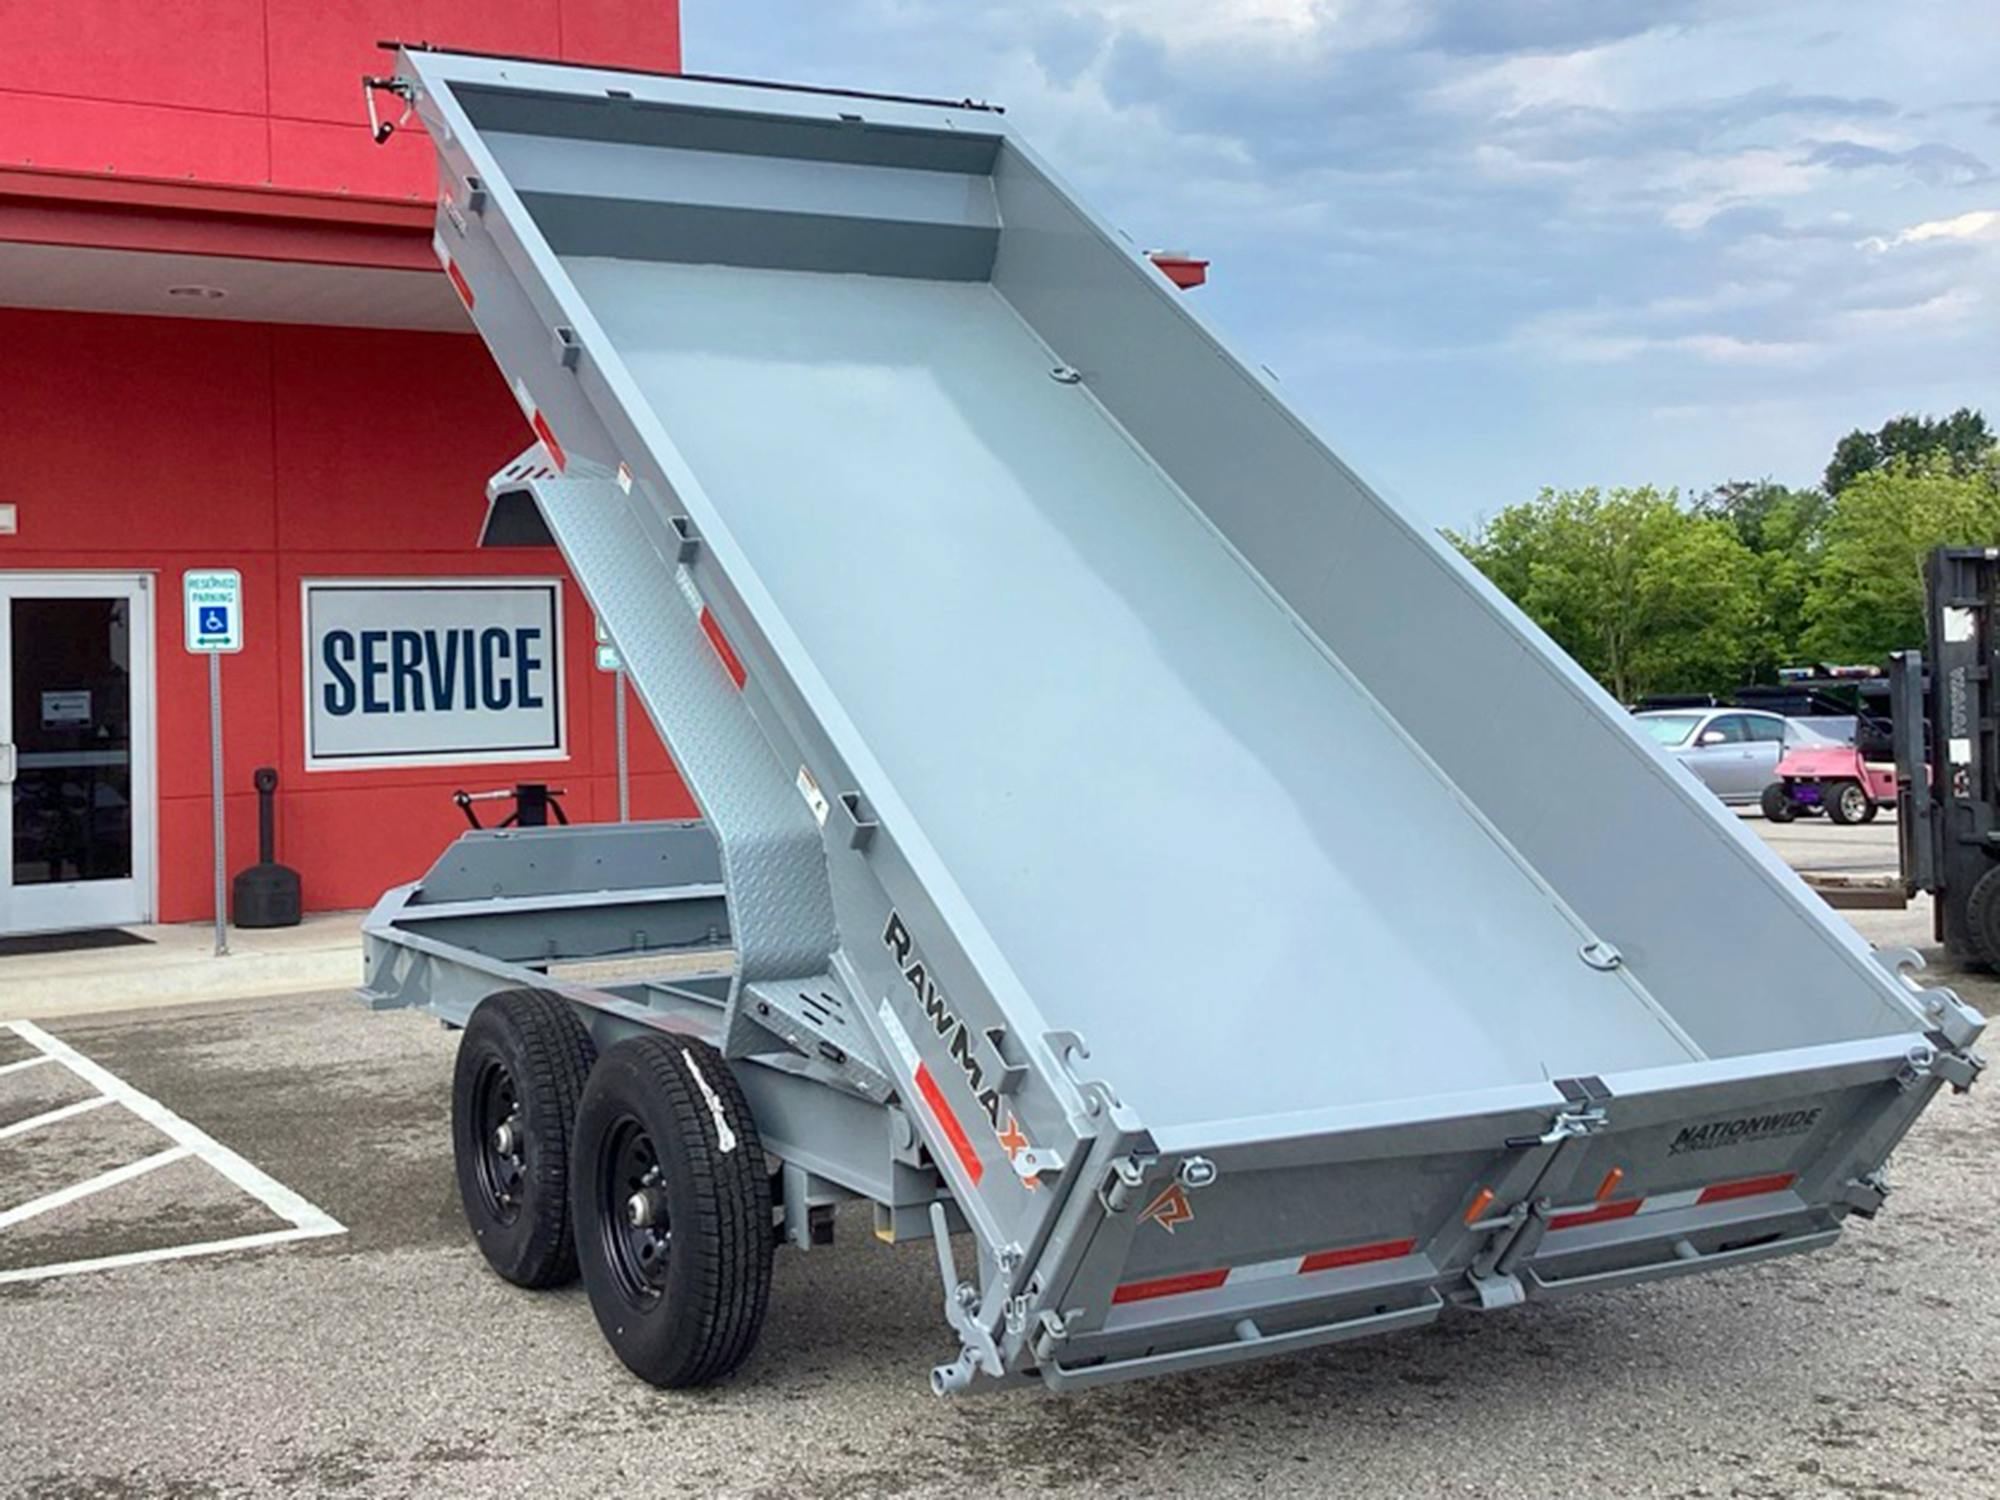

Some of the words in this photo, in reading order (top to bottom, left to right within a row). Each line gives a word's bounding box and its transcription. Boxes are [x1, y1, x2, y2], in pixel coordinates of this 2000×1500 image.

[188, 578, 235, 589] RESERVED
[192, 592, 233, 602] PARKING
[323, 627, 544, 716] SERVICE
[1675, 1108, 1823, 1146] NATIONWIDE
